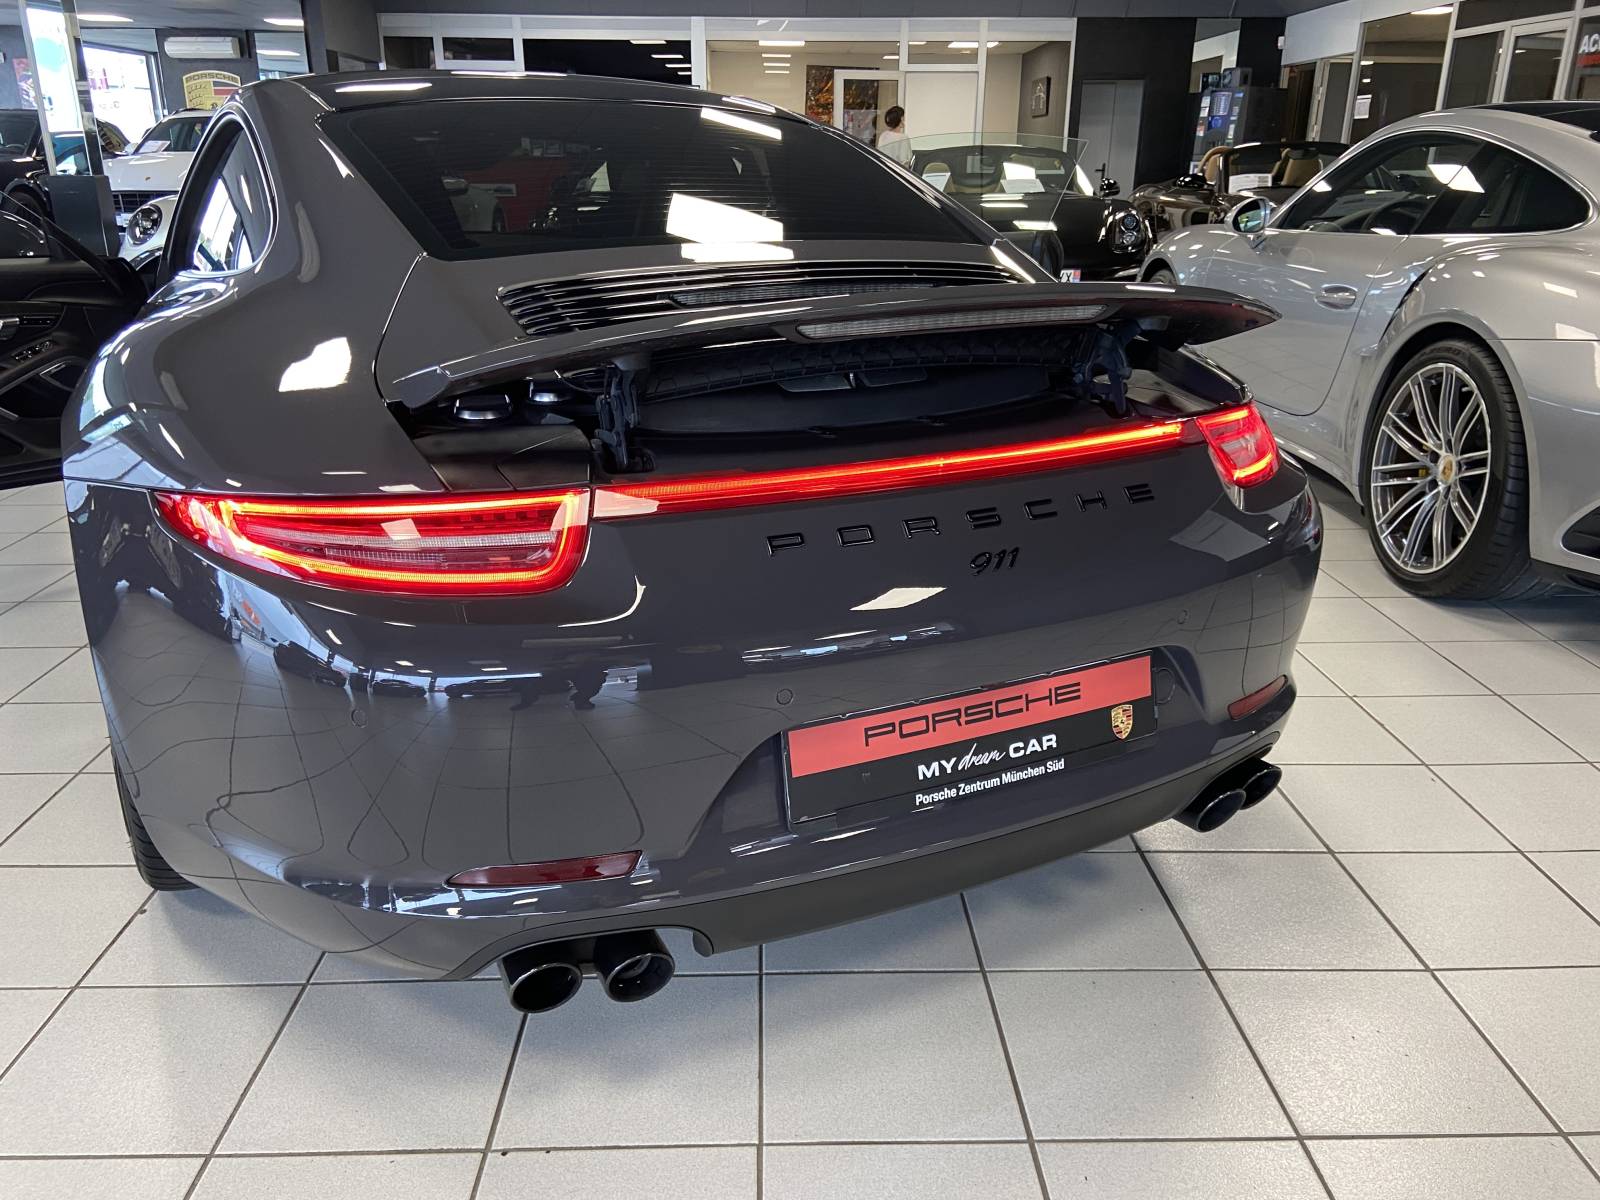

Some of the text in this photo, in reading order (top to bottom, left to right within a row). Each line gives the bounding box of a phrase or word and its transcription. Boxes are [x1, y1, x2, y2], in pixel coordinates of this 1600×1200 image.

[1578, 33, 1600, 54] AC
[185, 71, 239, 84] PORSCHE
[766, 483, 1155, 557] PORSCHE
[969, 546, 1020, 577] 911
[864, 682, 1081, 747] PORSCHE
[917, 734, 1058, 781] MY dream CAR
[915, 757, 1066, 806] Porsche Zentrum München Süd
